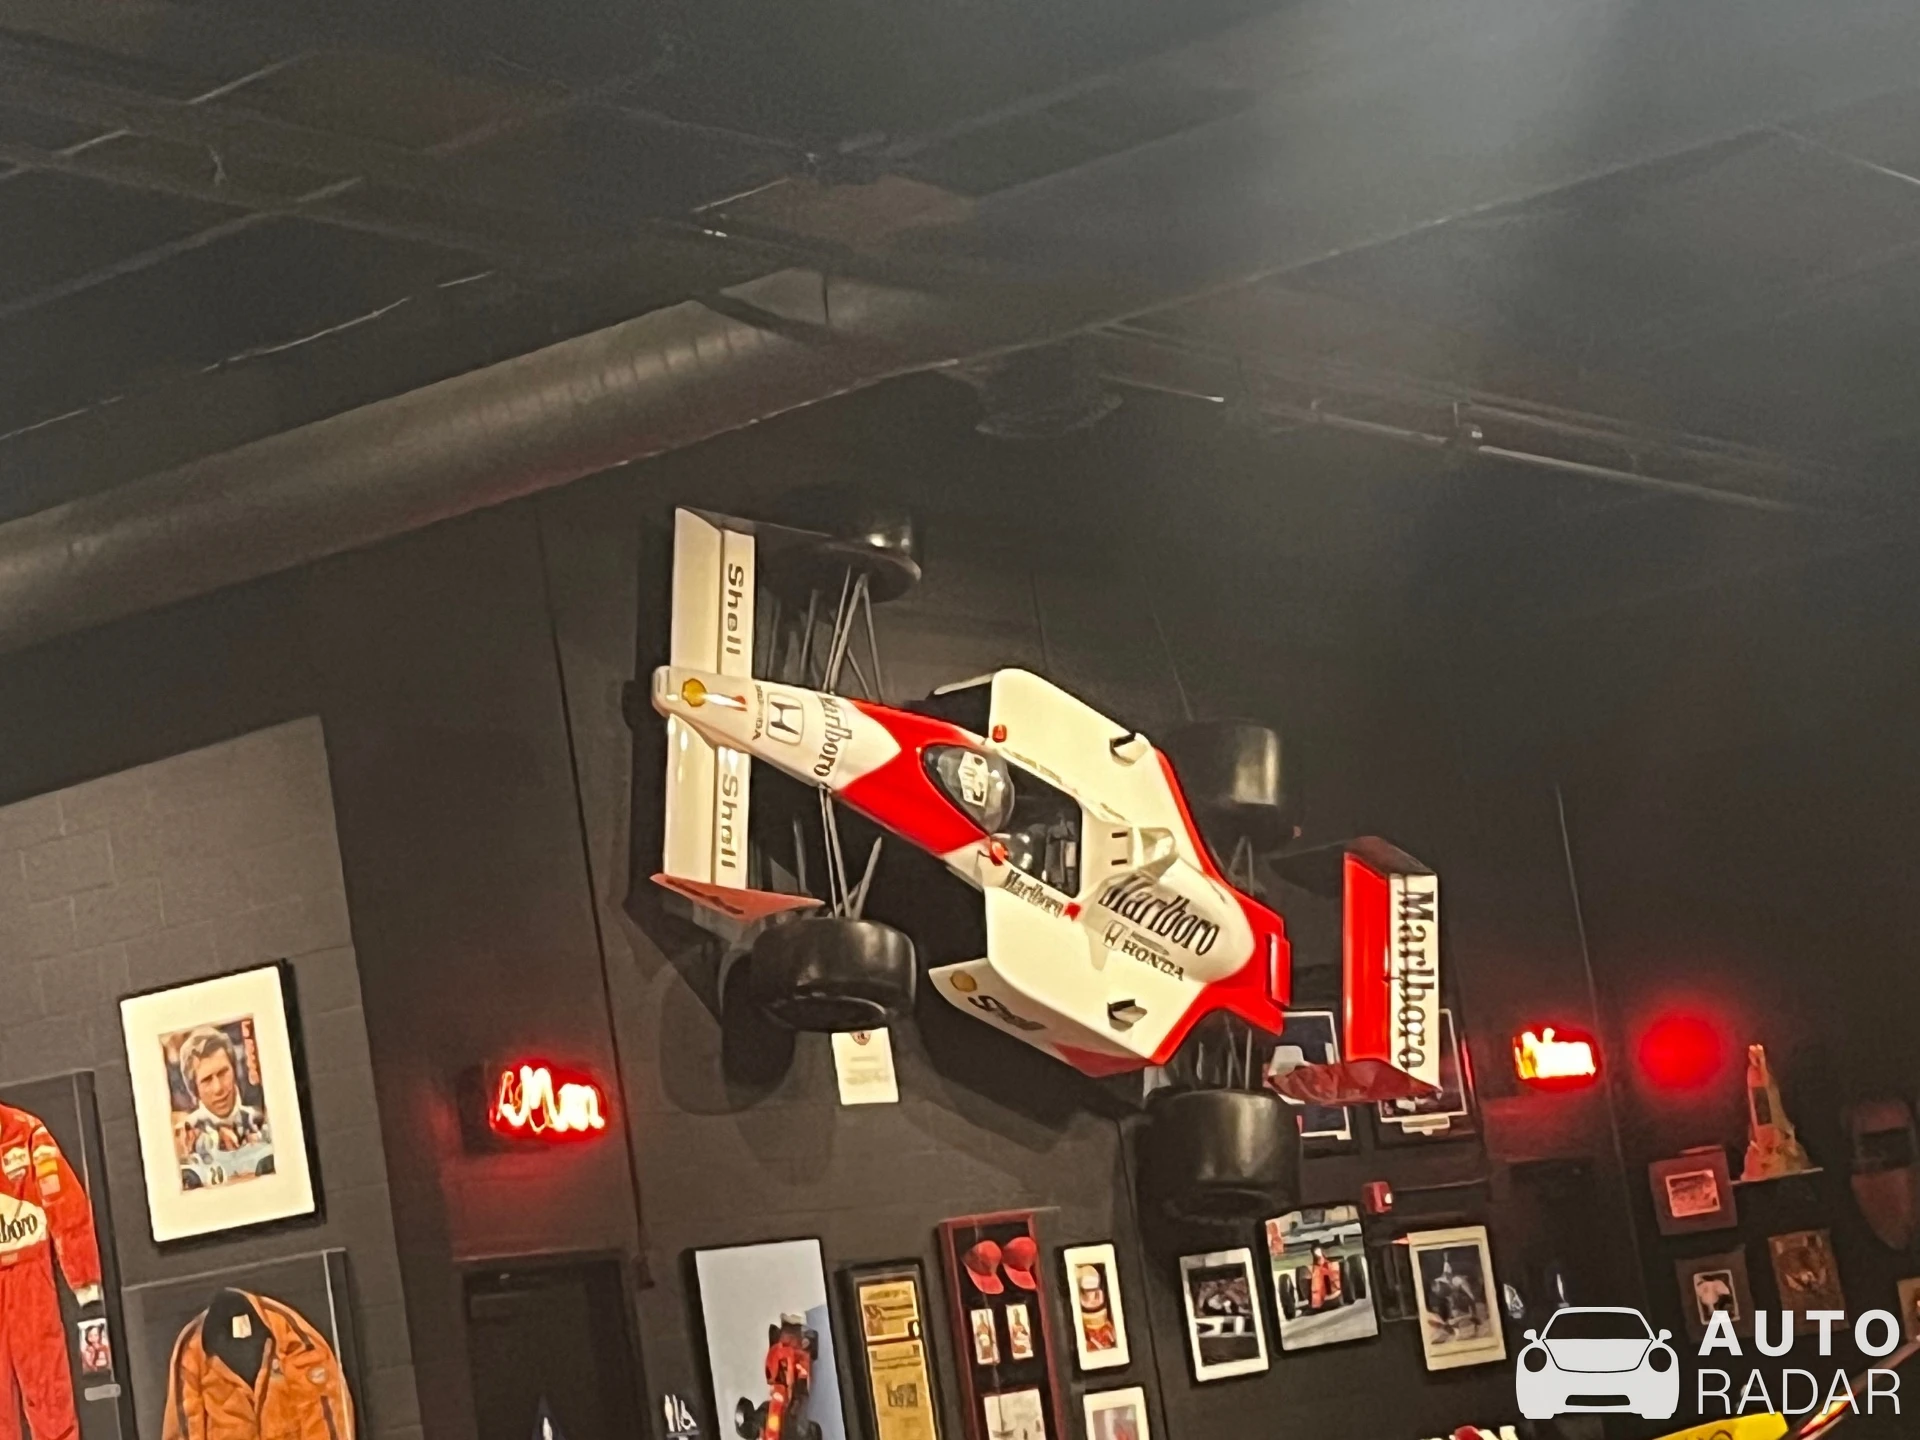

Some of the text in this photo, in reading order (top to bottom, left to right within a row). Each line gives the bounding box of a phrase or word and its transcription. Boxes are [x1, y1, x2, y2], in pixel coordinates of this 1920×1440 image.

[725, 562, 744, 656] Shell
[719, 772, 739, 869] Shell
[1121, 938, 1184, 981] HONDA
[1397, 890, 1435, 1073] Marlboro
